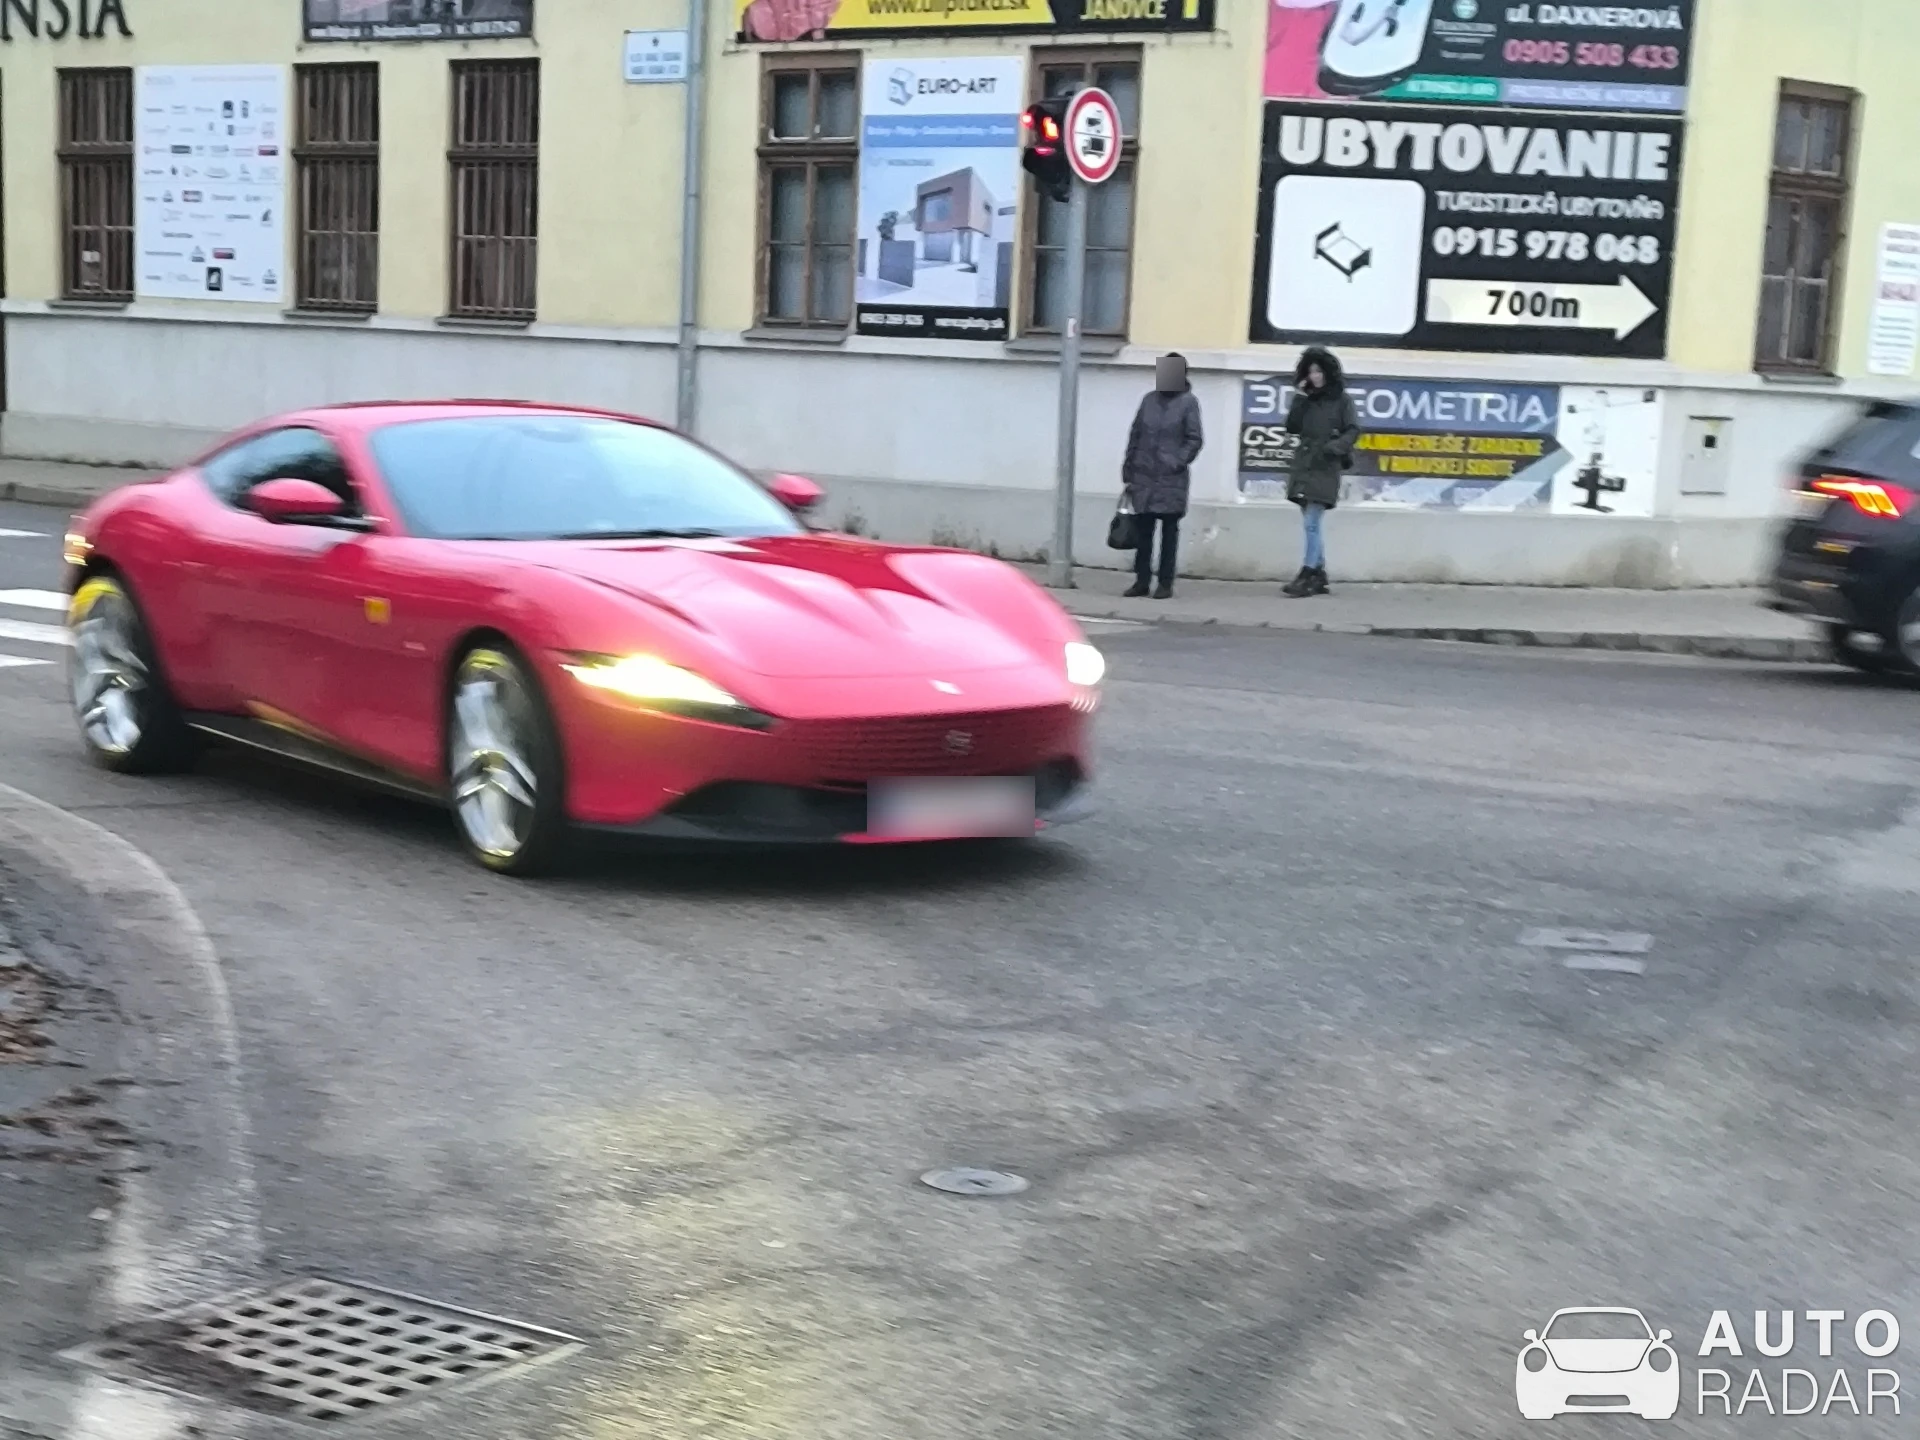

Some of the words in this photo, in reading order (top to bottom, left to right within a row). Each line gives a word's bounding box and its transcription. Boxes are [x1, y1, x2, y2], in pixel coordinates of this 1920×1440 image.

[1505, 3, 1533, 24] ul.
[1538, 5, 1684, 30] DAXNEROVÁ
[1503, 38, 1570, 65] 0905
[1574, 42, 1625, 67] 508
[1628, 44, 1680, 69] 433
[917, 77, 998, 95] EURO-ART
[1279, 115, 1673, 181] UBYTOVANIE
[1434, 190, 1560, 216] TURISTICKÁ
[1560, 194, 1665, 220] UBYTOVŇA
[1432, 226, 1519, 258] 0915
[1524, 230, 1590, 261] 978
[1594, 232, 1661, 264] 068
[1487, 289, 1581, 319] 700m
[1344, 388, 1549, 424] EOMETRIA
